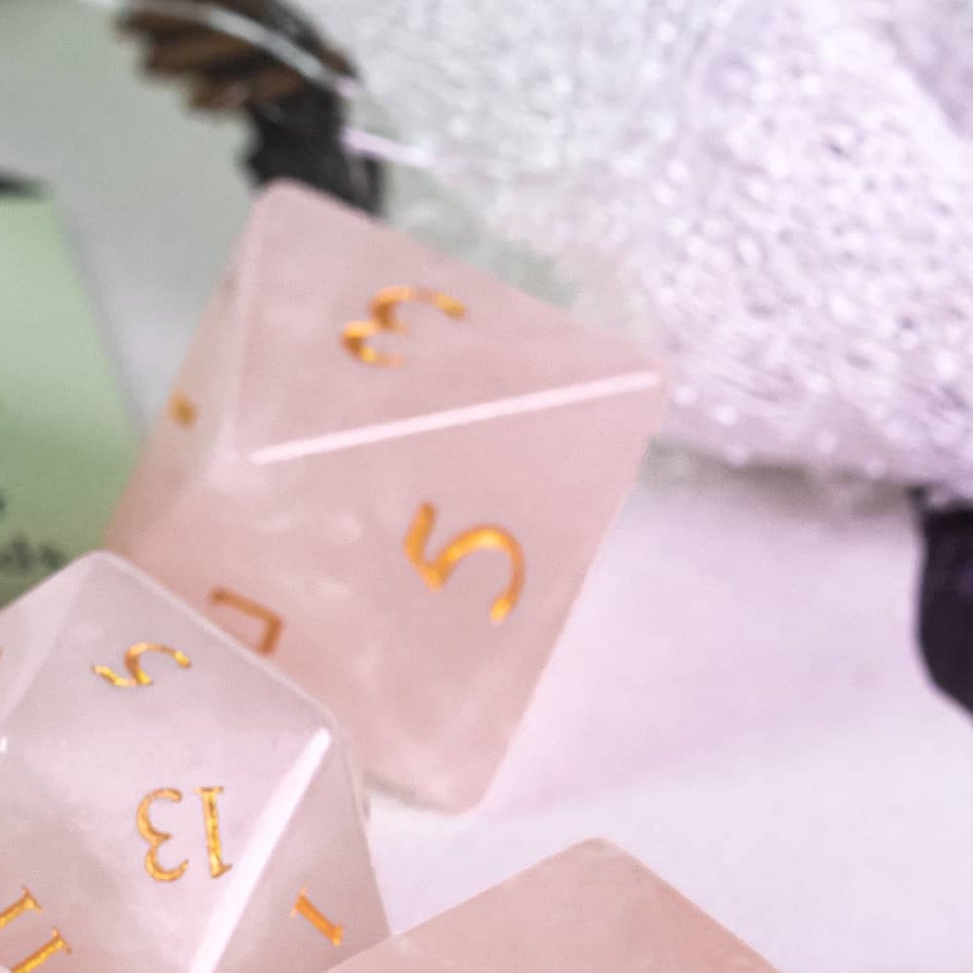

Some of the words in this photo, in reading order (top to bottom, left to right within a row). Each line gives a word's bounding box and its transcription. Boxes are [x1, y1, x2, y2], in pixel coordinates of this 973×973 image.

[341, 286, 467, 367] 3
[404, 501, 526, 624] 5
[136, 786, 231, 882] 13
[291, 887, 344, 947] 1
